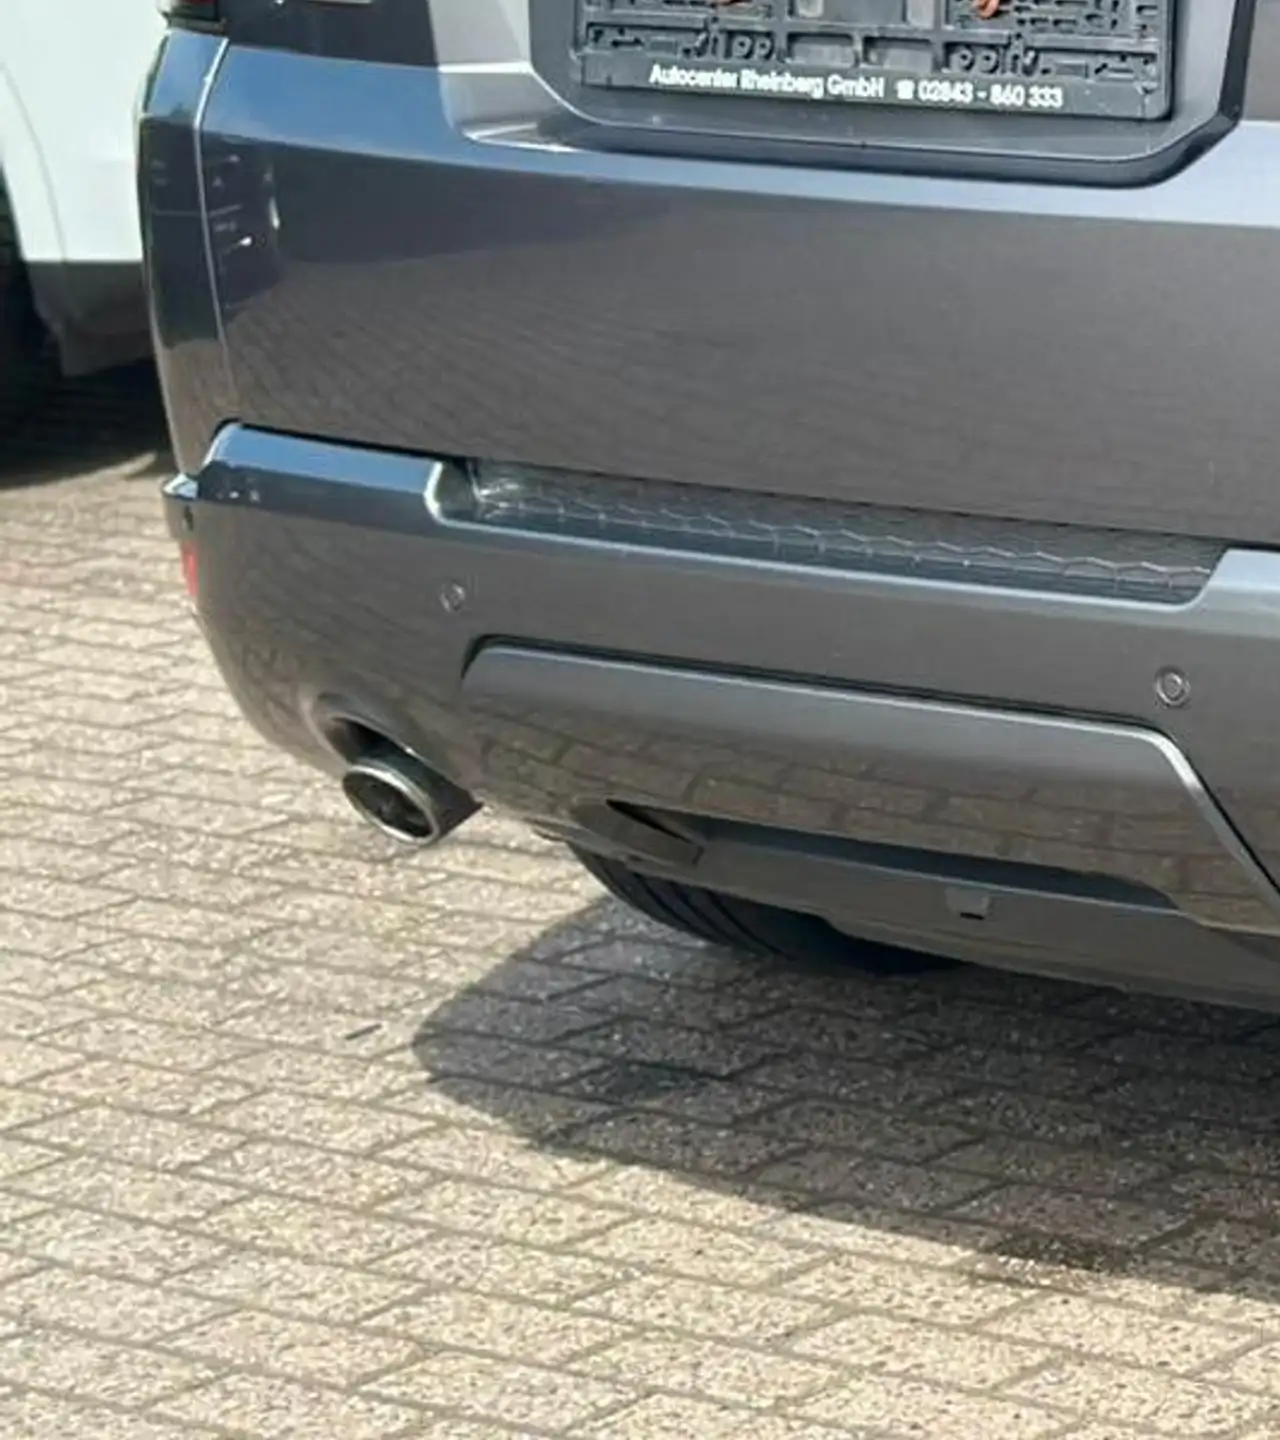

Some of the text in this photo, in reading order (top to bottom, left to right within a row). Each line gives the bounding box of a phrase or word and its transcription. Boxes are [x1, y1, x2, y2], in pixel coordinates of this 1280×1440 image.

[649, 63, 737, 89] Autocenter
[740, 69, 824, 99] Rheinberg
[827, 73, 885, 97] GmbH
[918, 79, 974, 104] 02843
[989, 84, 1026, 107] 860
[1028, 86, 1064, 108] 333
